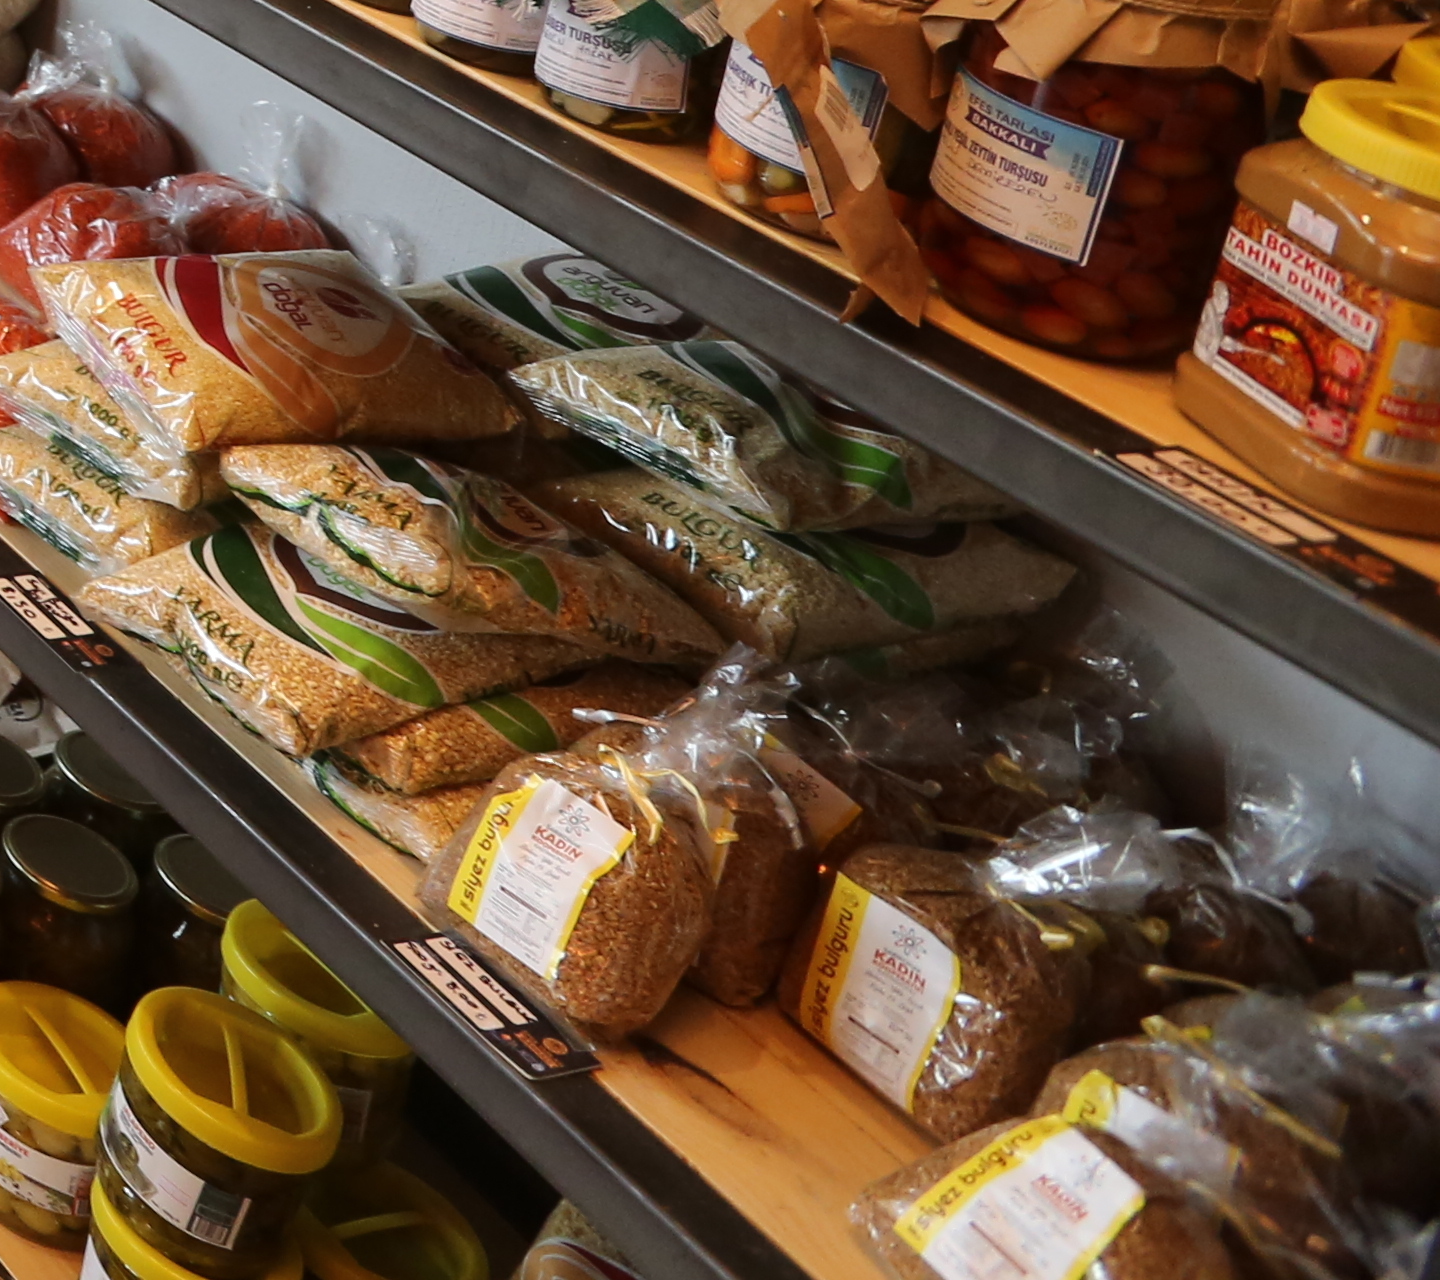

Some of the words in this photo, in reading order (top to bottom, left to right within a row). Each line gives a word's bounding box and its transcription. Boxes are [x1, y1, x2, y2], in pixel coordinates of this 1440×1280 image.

[968, 93, 994, 118] EFES
[994, 108, 1055, 144] TARLASI
[971, 112, 1038, 152] BAKKALI
[969, 137, 998, 166] ZEYTİN
[998, 156, 1048, 188] TURŞUSU
[1229, 231, 1281, 274] TAHİN
[1286, 268, 1375, 333] DÜNYASI
[1266, 232, 1340, 288] BOZKIR
[262, 281, 315, 332] doğal
[561, 263, 655, 315] arguvan
[115, 292, 189, 378] BULGUR
[173, 586, 255, 668] YARMA
[534, 824, 584, 861] KADIN
[820, 907, 855, 981] bulguru
[873, 948, 927, 991] KADIN
[814, 982, 833, 1030] siyez
[961, 1130, 1034, 1185] bulguru
[1037, 1173, 1088, 1220] KADIN
